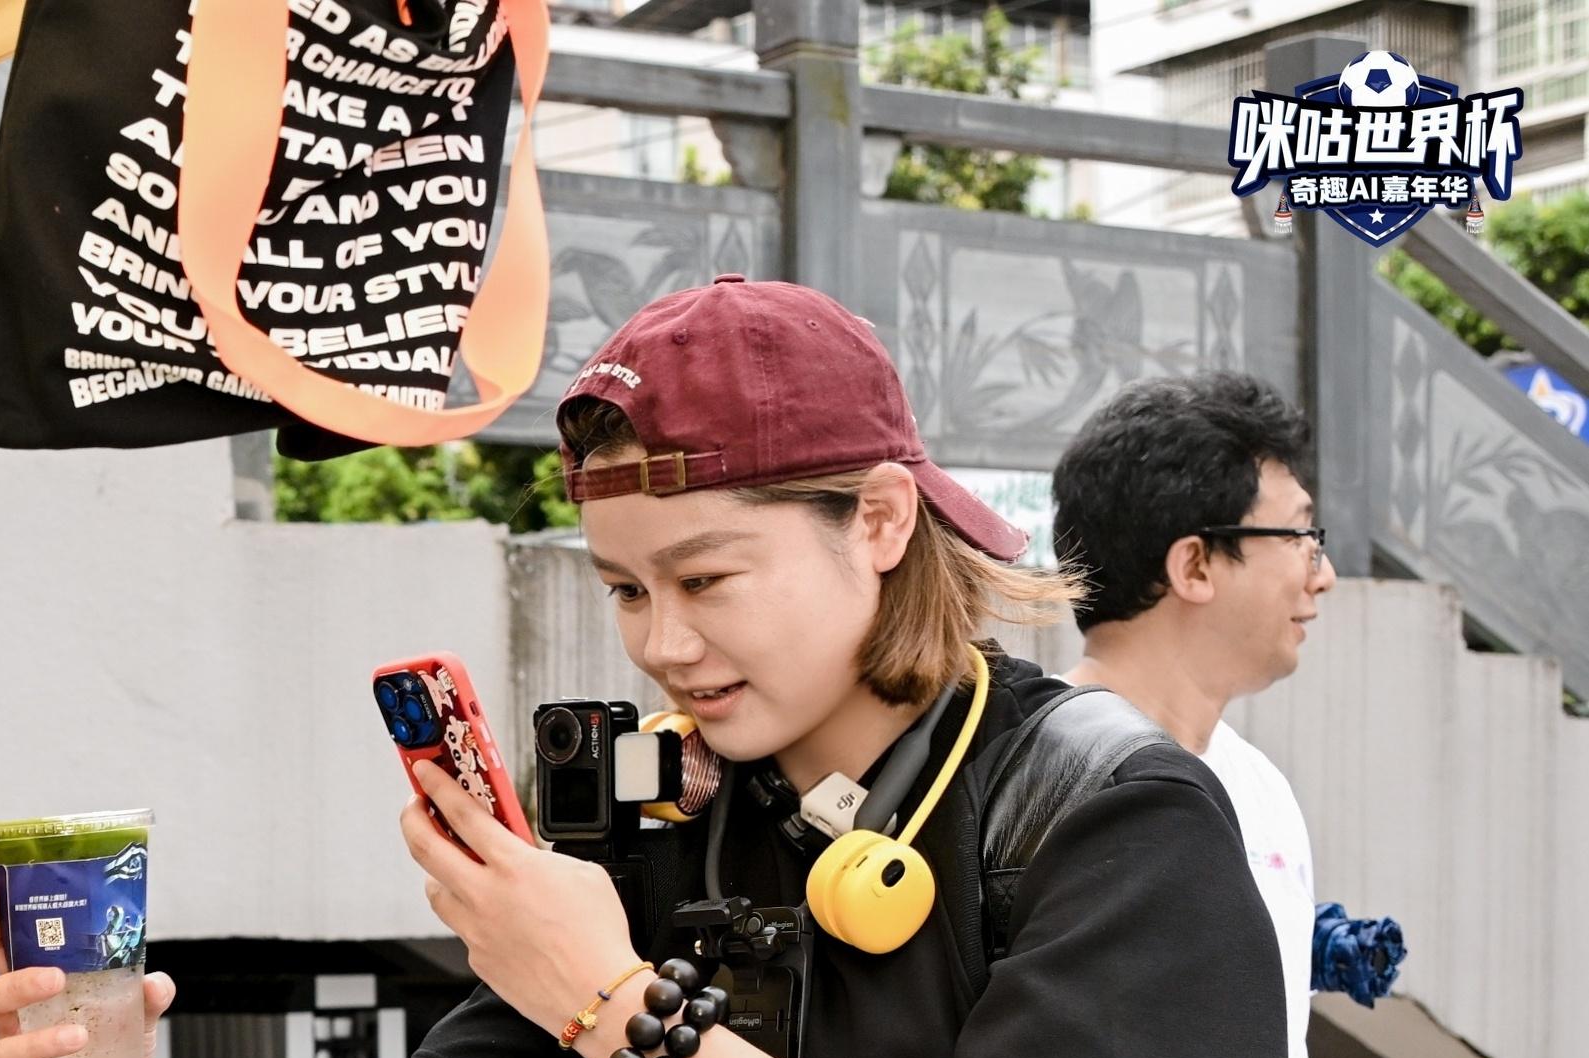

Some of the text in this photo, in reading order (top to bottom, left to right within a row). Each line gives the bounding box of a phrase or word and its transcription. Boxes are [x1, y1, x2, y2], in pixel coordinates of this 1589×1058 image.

[349, 25, 419, 63] AS
[301, 44, 430, 97] CHANCE
[432, 77, 476, 100] TO
[283, 80, 367, 129] AKE
[388, 175, 487, 212] YOU
[335, 234, 383, 270] OF
[392, 217, 487, 252] YOU
[79, 231, 202, 300] BRIN
[237, 279, 356, 314] YOUR
[78, 266, 212, 342] YOU
